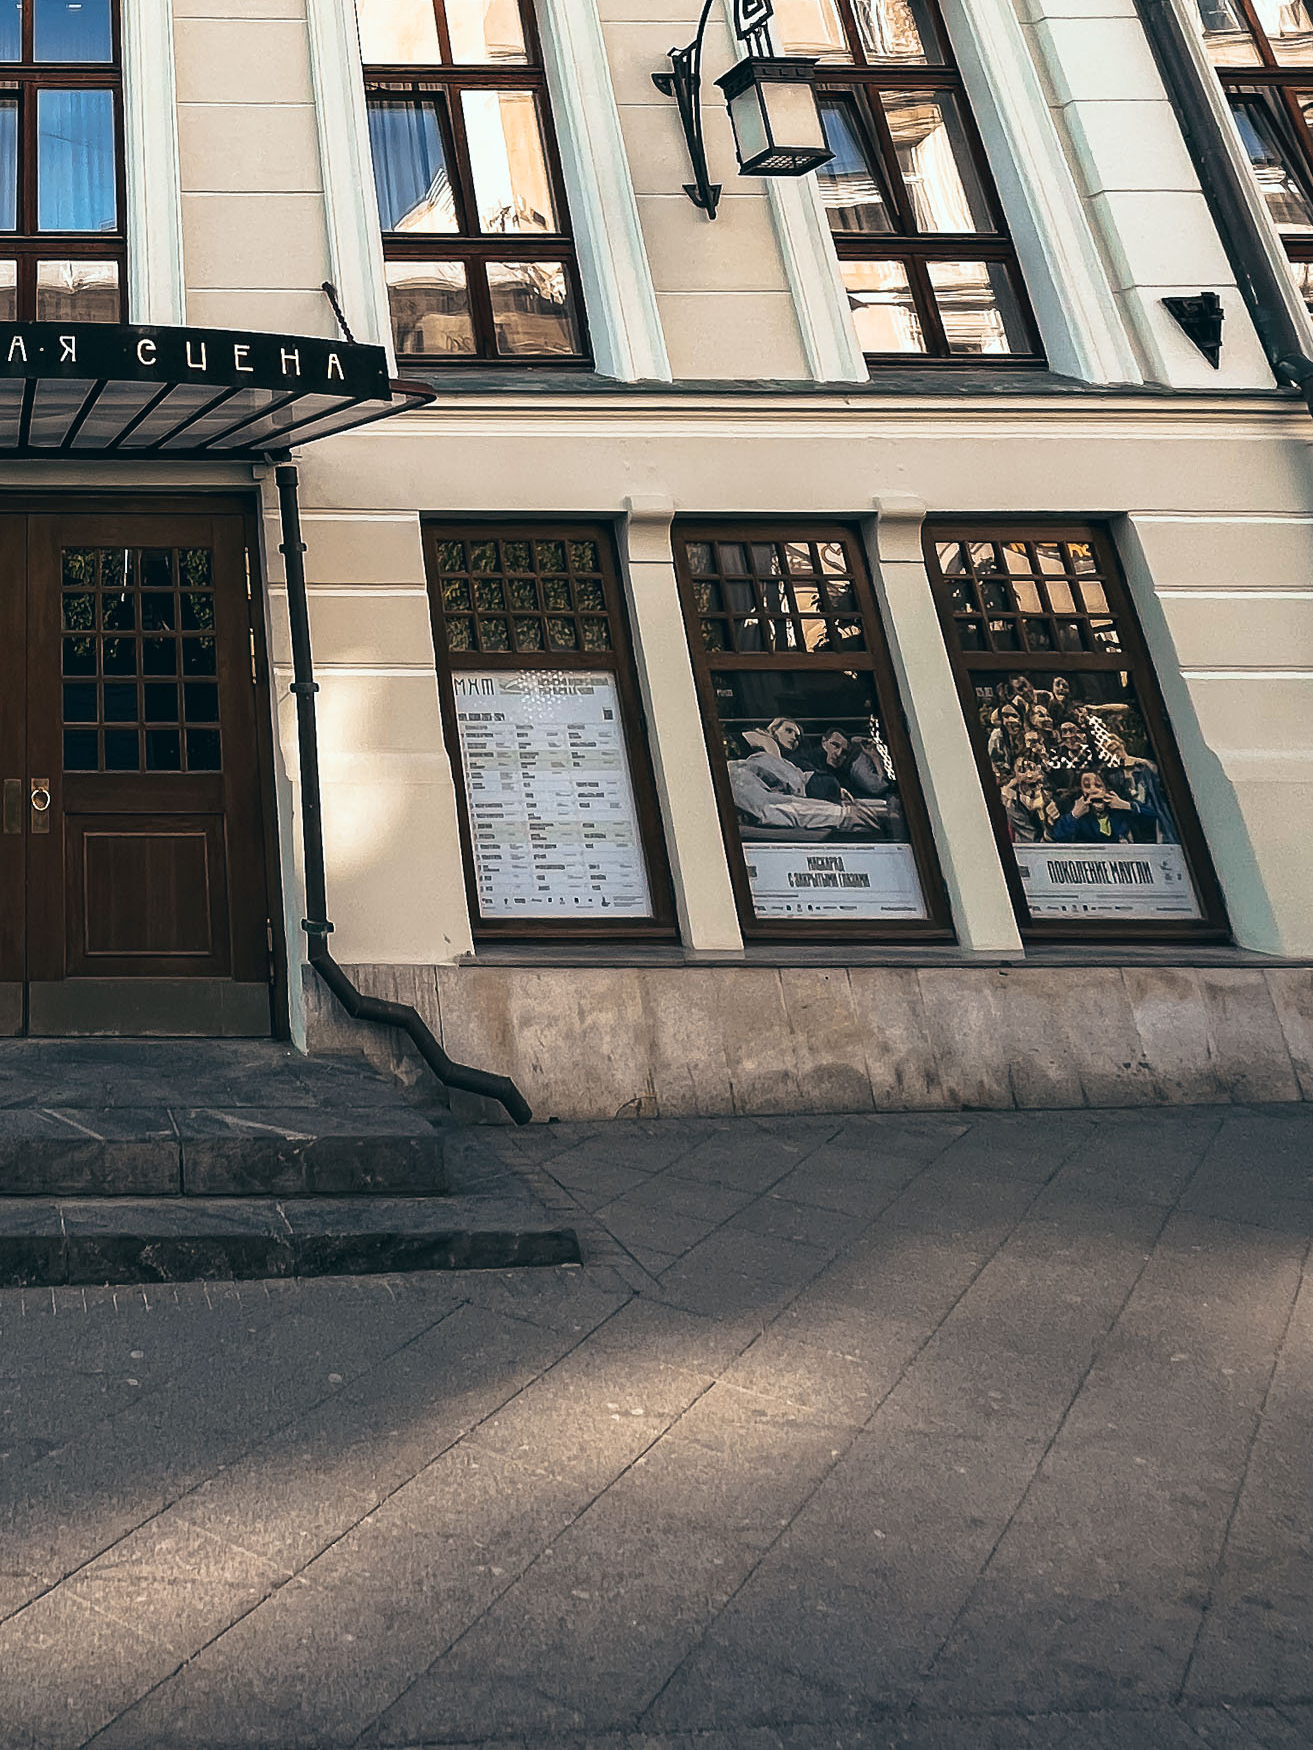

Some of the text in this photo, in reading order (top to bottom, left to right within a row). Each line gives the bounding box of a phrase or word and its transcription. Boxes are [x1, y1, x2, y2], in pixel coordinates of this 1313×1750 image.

[137, 340, 345, 381] СЦЕНА
[788, 873, 795, 888] С
[1047, 860, 1155, 884] ПОКОЛЕНИЕ МАУГЛИ
